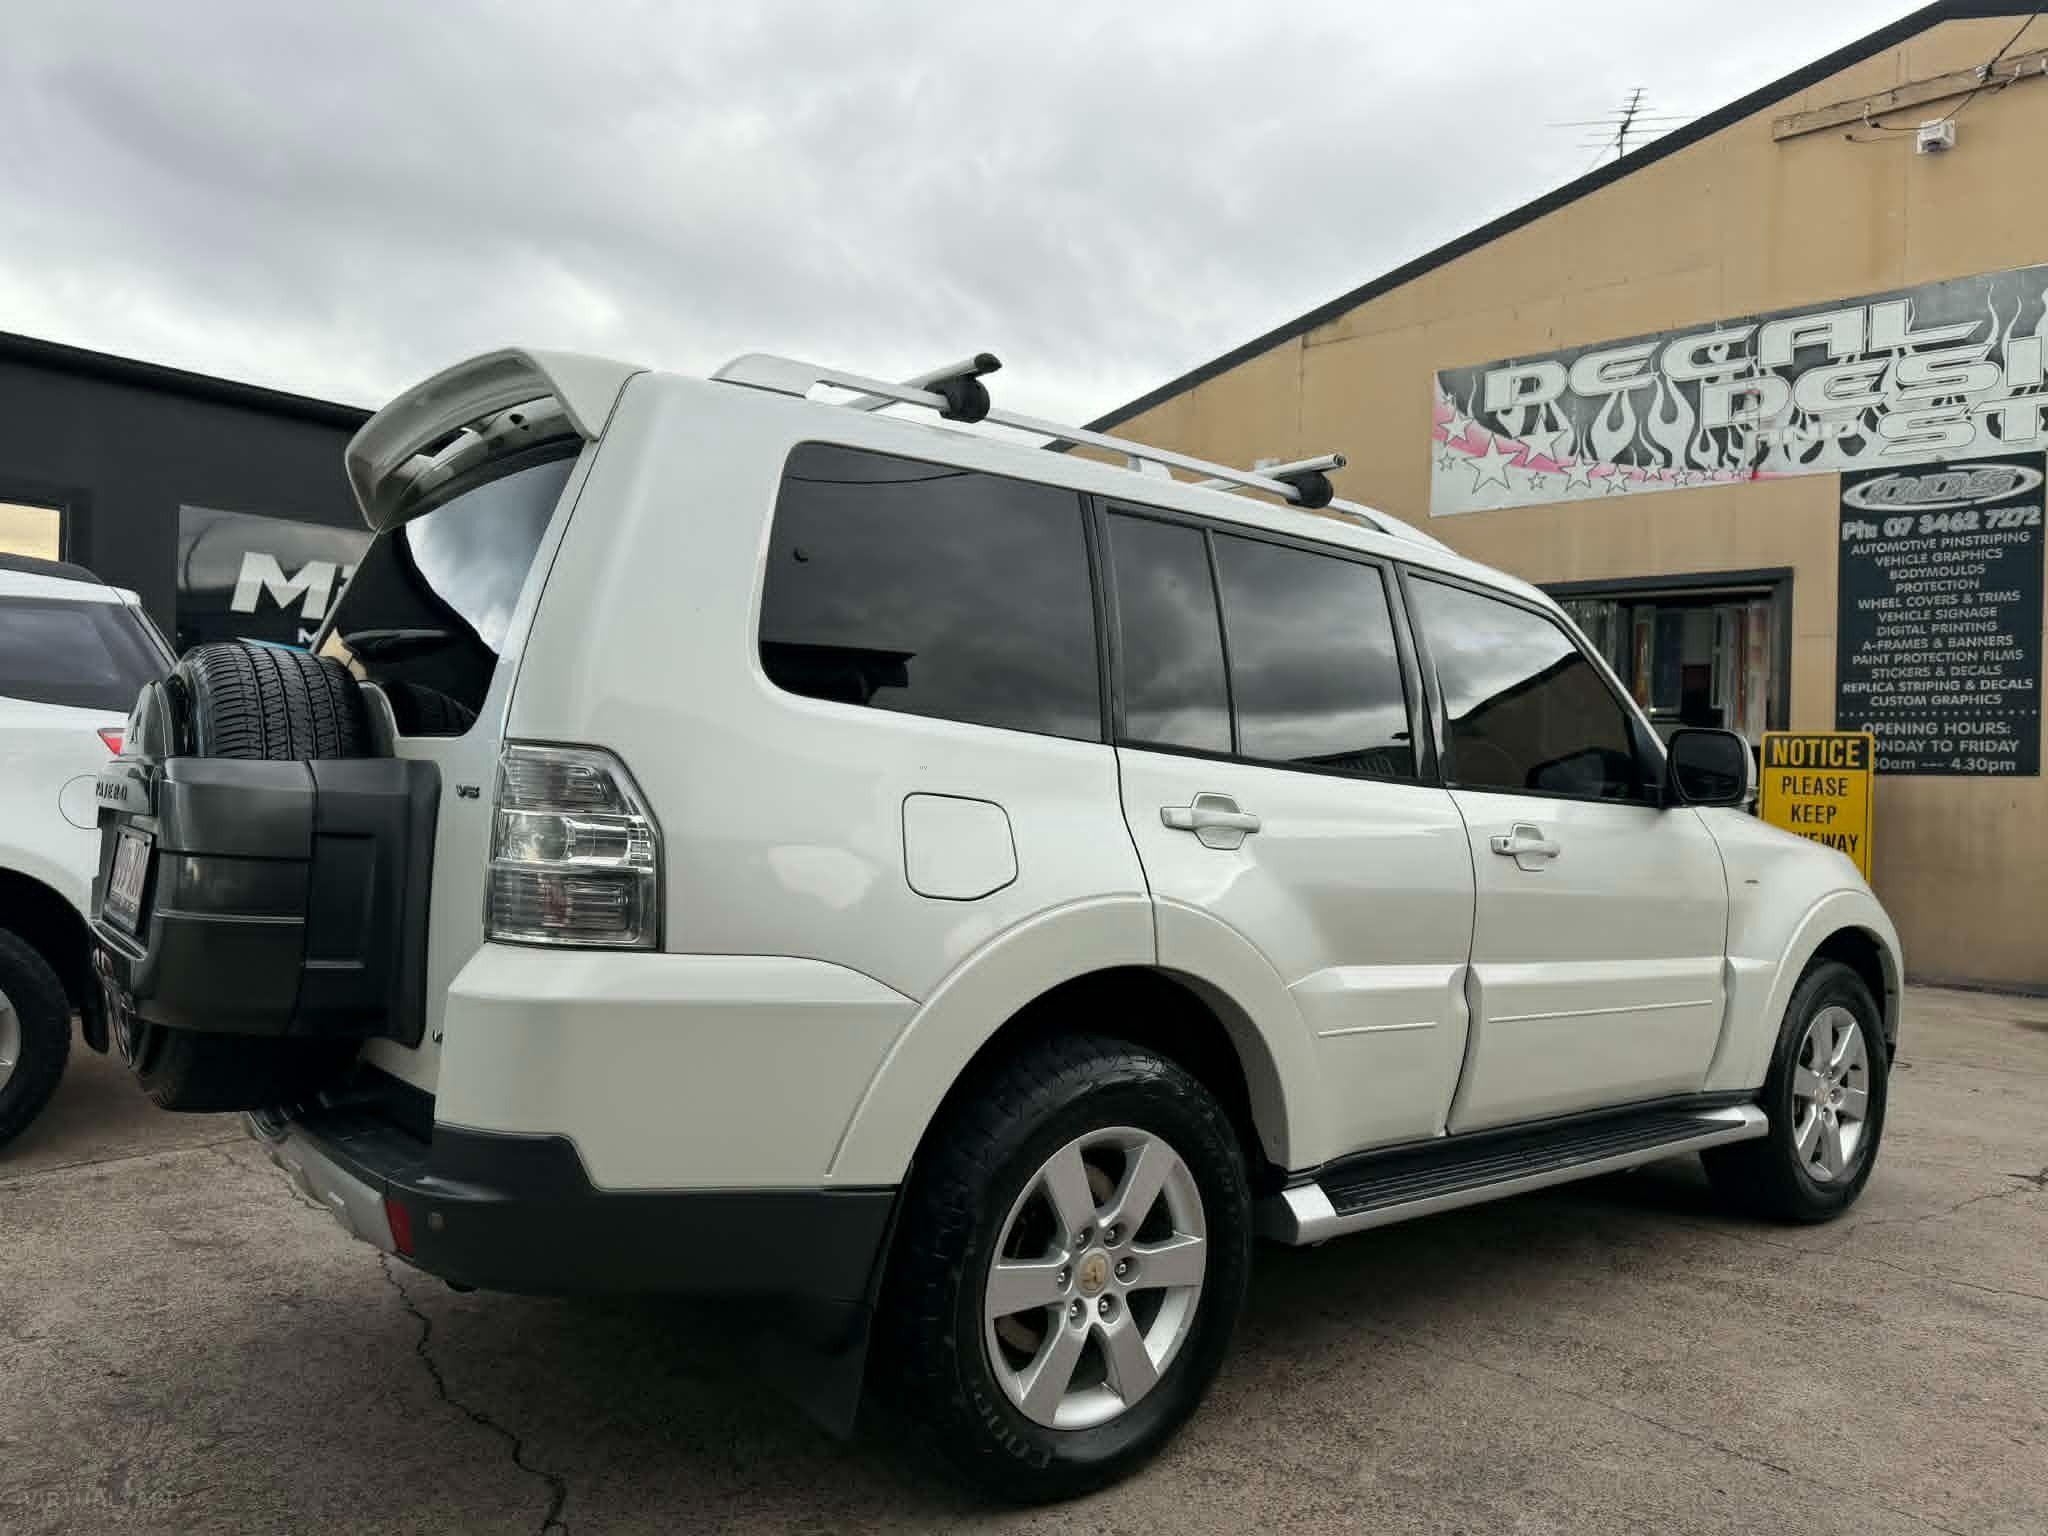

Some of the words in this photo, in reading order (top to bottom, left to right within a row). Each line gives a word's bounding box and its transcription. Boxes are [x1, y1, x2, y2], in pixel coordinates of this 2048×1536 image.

[1884, 517, 1914, 537] 07
[1919, 512, 1980, 533] 3462
[1984, 506, 2041, 528] 7272
[1850, 538, 1936, 555] AUTOMOTIVE
[1941, 532, 2031, 547] PINSTRIPING
[1875, 552, 1929, 567] VEHICLE
[1932, 548, 2003, 562] GRAPHICS
[1889, 564, 1985, 580] BODYMOULDS
[1895, 579, 1980, 594] PROTECTION
[1858, 598, 1902, 610] WHEEL
[1906, 594, 1959, 607] COVERS
[1962, 594, 1973, 604] &
[1978, 590, 2021, 602] TRIMS
[1878, 610, 1930, 623] VEHICLE
[1935, 607, 1998, 619] SIGNAGE
[1876, 624, 1926, 637] DIGITAL
[1931, 622, 1998, 633] PRINTING
[1862, 638, 1929, 651] A-FRAMES
[1933, 638, 1943, 647] &
[1948, 635, 2014, 647] BANNERS
[1852, 653, 1890, 665] PAINT
[1894, 651, 1977, 664] PROTECTION
[1983, 649, 2024, 661] FILMS
[1872, 667, 1930, 679] STICKERS
[1935, 666, 1945, 676] &
[1950, 665, 2002, 676] DECALS
[1843, 681, 1894, 693] REPLICA
[1898, 680, 1960, 692] STRIPING
[1965, 680, 1975, 690] &
[1980, 678, 2033, 690] DECALS
[1870, 695, 1927, 706] CUSTOM
[1931, 694, 2002, 705] GRAPHICS
[1862, 722, 1938, 736] OPENING
[1944, 721, 2011, 735] HOURS:
[1772, 738, 1861, 766] NOTICE
[1874, 740, 1925, 753] ONDAY
[1930, 740, 1953, 752] TO
[1960, 740, 2019, 753] FRIDAY
[1873, 757, 1915, 770] 30am
[1951, 758, 2016, 773] 4.30pm
[1781, 776, 1849, 797] PLEASE
[1791, 805, 1837, 824] KEEP
